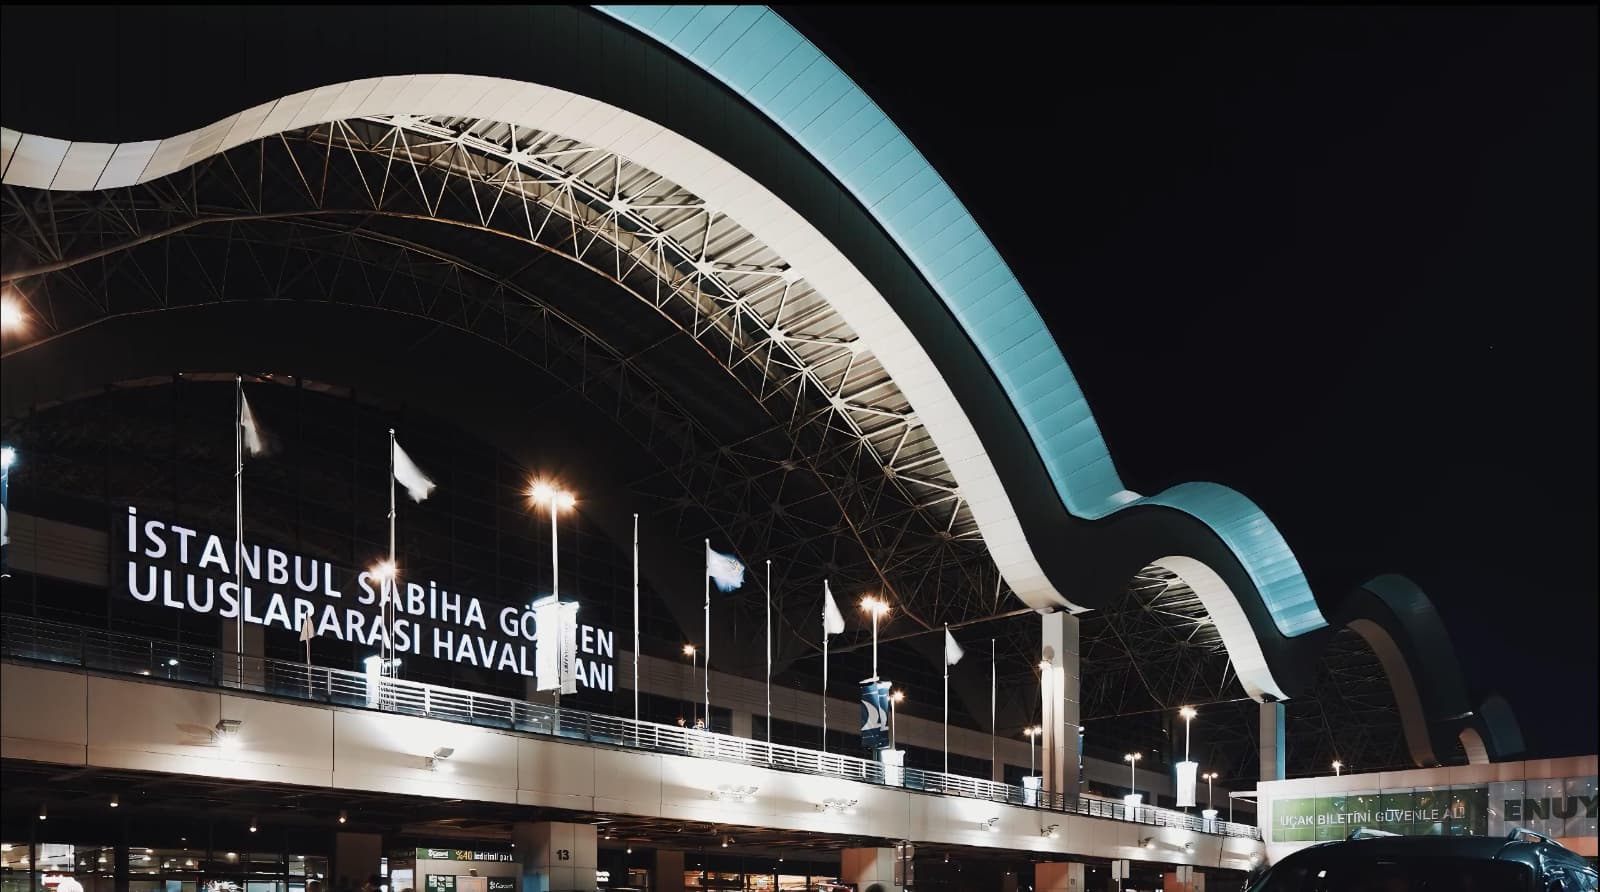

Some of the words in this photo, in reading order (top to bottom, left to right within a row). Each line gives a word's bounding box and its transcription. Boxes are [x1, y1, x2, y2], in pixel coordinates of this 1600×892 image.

[129, 506, 342, 598] İSTANBUL
[358, 571, 487, 630] SABİHA
[500, 604, 613, 659] GÖEN
[129, 561, 420, 655] ULUSLARARASI
[433, 627, 613, 692] HAVALANI
[556, 849, 569, 860] 13
[1280, 813, 1314, 829] UÇAK
